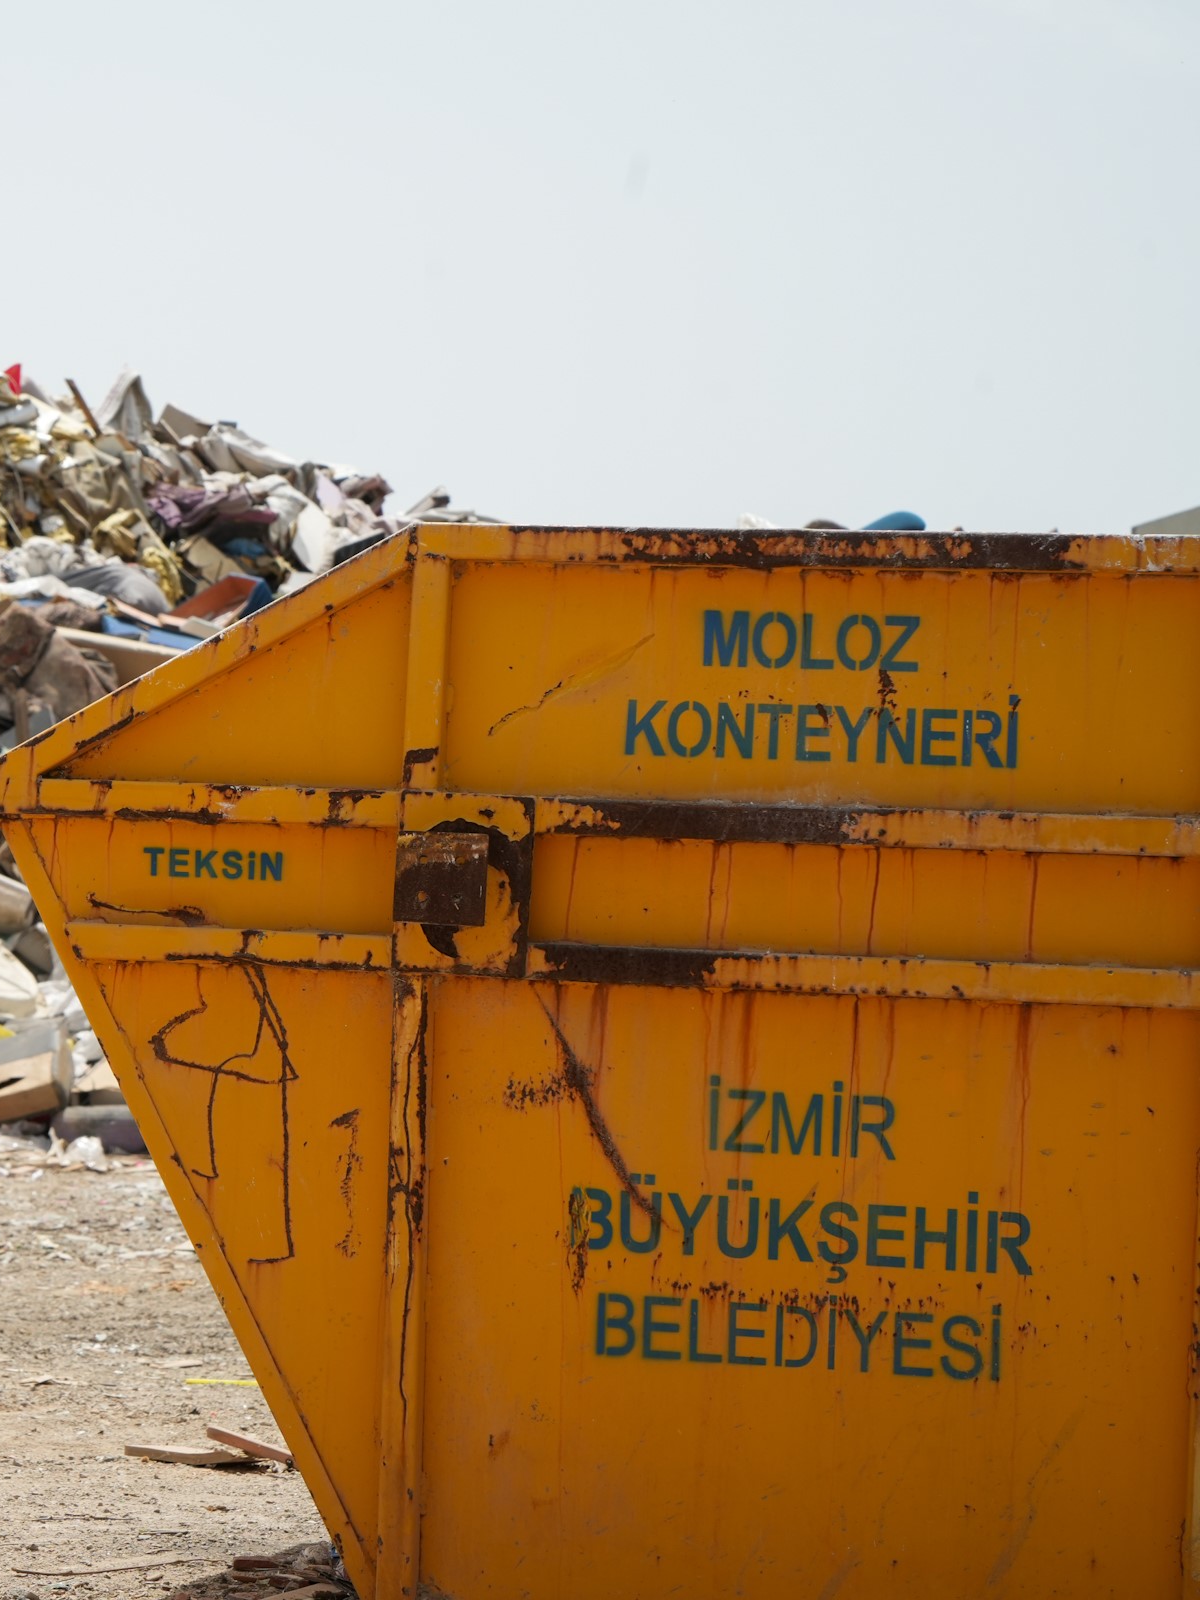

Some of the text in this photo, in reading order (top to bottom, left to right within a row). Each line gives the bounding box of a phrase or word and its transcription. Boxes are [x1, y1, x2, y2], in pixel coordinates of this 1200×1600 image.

[702, 609, 921, 673] MOLOZ
[624, 694, 1020, 769] KONTEYNERİ
[709, 1075, 897, 1161] İZMİR
[570, 1172, 1034, 1284] BÜYÜKŞEHİR
[594, 1292, 1003, 1382] BELEDİYESİ
